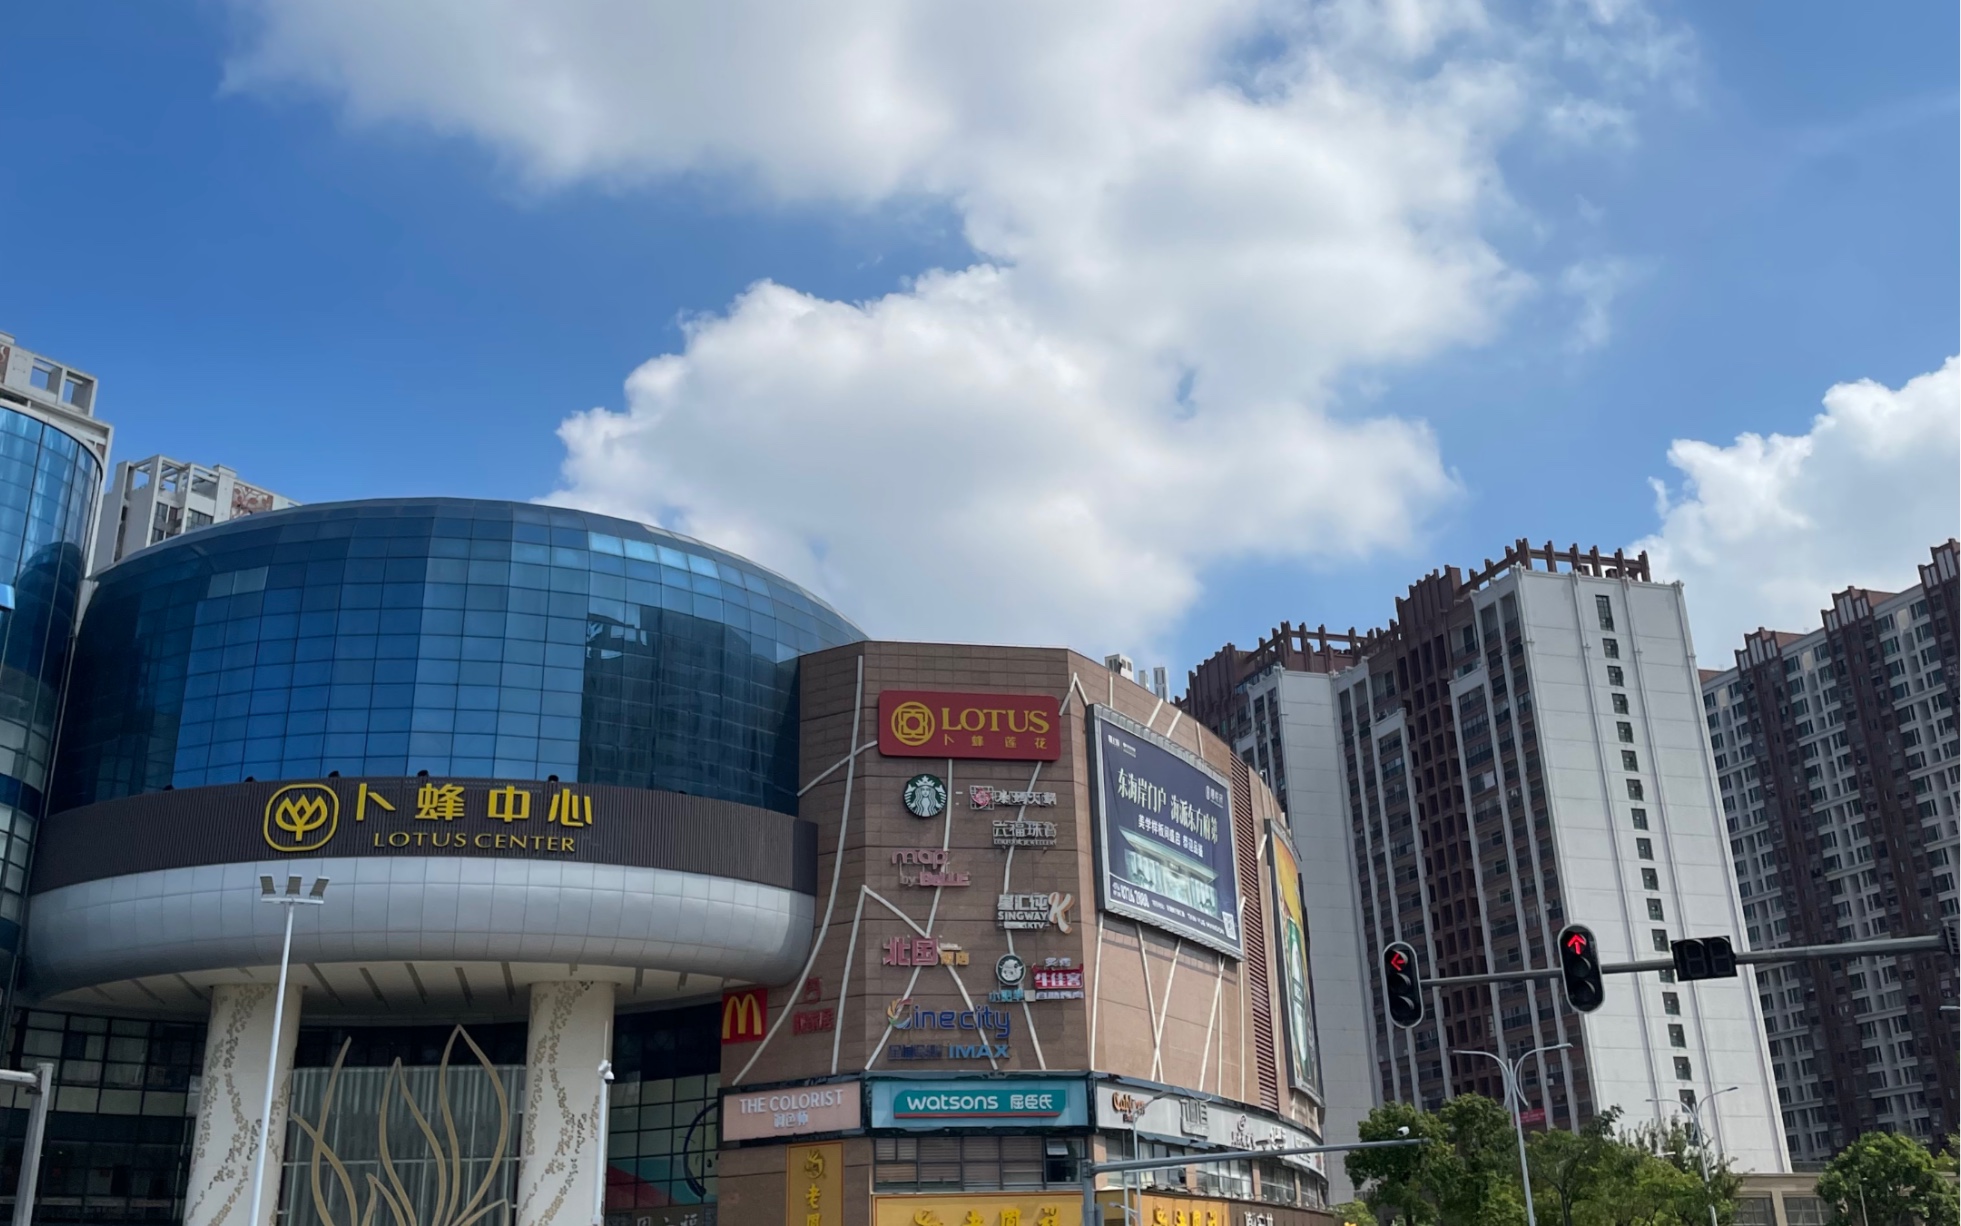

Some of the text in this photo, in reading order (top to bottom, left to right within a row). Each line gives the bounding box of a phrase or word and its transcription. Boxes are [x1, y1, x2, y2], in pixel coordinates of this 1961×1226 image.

[941, 707, 1050, 733] LOTUS
[944, 733, 1047, 750] 卜蜂莲花
[355, 783, 593, 827] 卜蜂中心
[373, 832, 576, 851] LOTUS CENTER
[891, 849, 948, 870] map
[997, 911, 1048, 920] SINGWAY
[948, 1044, 1010, 1059] IMAX
[740, 1089, 844, 1114] THE COLORIST
[906, 1094, 1053, 1111] watsons 屈臣氏
